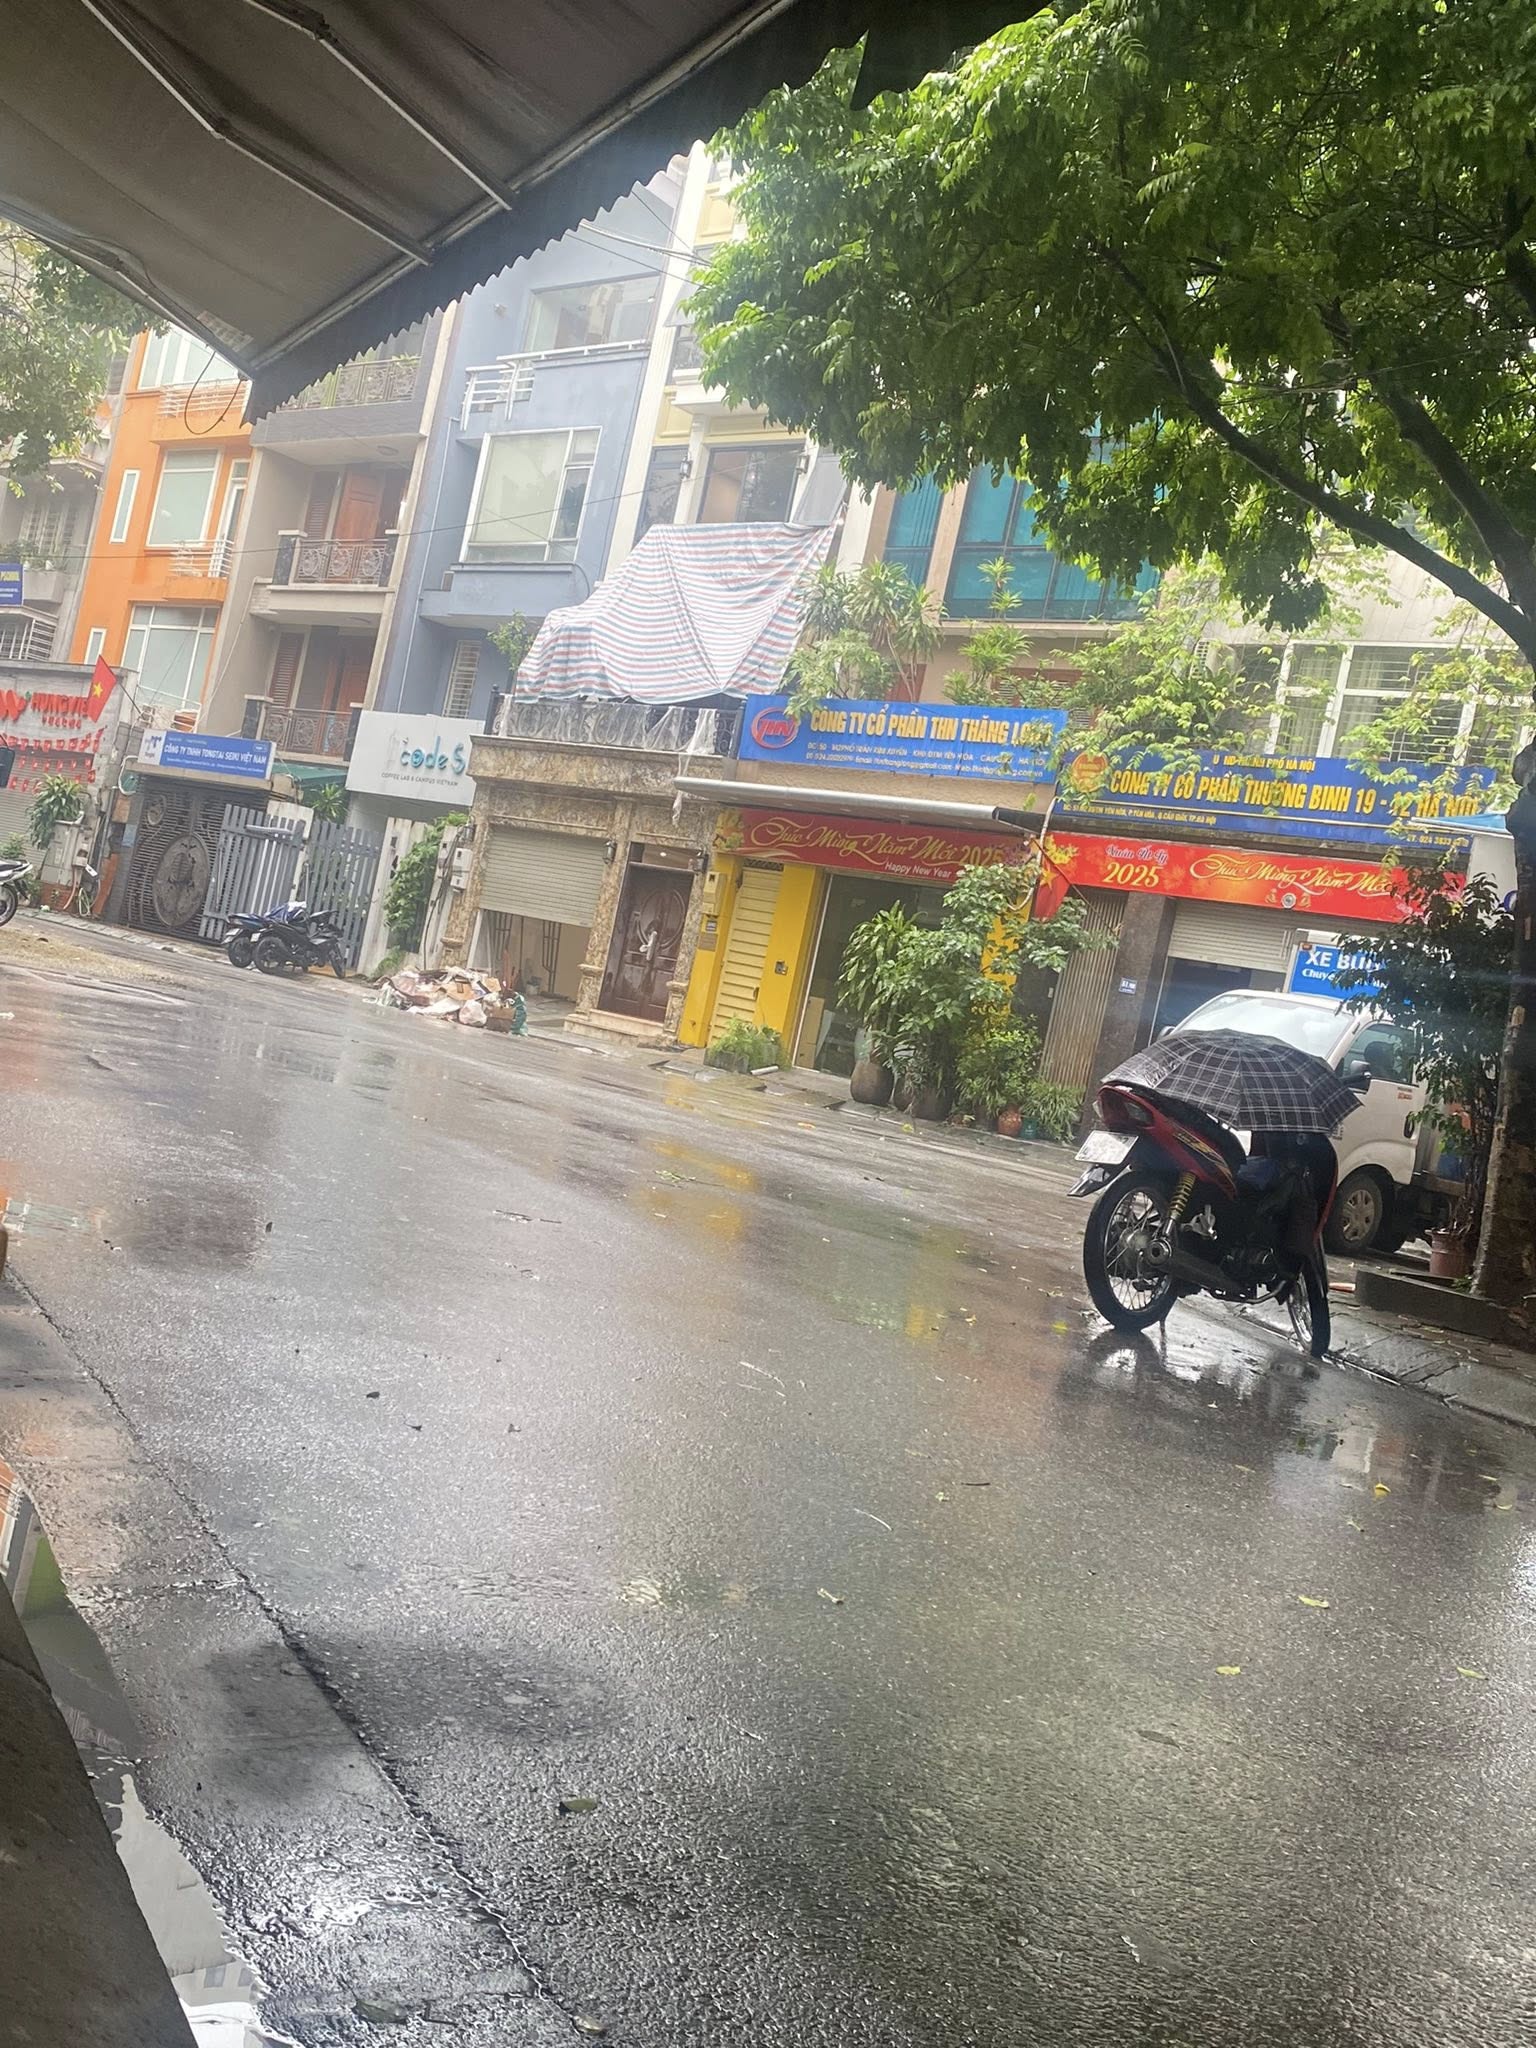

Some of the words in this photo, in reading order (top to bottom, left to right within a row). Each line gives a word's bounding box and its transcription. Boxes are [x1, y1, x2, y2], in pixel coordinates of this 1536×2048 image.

[31, 692, 91, 716] HUNGVIE
[849, 712, 866, 734] TY
[866, 703, 889, 736] CỔ
[887, 707, 928, 739] PHẦN
[930, 715, 959, 742] THN
[960, 714, 1010, 744] THĂNG
[1011, 721, 1054, 748] LO
[179, 745, 186, 754] TY
[187, 747, 201, 757] TNHH
[240, 751, 253, 765] VIỆT
[253, 755, 267, 765] NAM
[1299, 758, 1316, 773] NỘI
[381, 772, 400, 781] COFFEE
[1309, 784, 1352, 813] BINH
[1355, 788, 1377, 814] 19
[1391, 791, 1411, 817] 12
[884, 861, 911, 875] Happy
[912, 865, 930, 876] New
[933, 867, 952, 879] Year
[1102, 861, 1164, 888] 2025
[1305, 951, 1333, 967] XE
